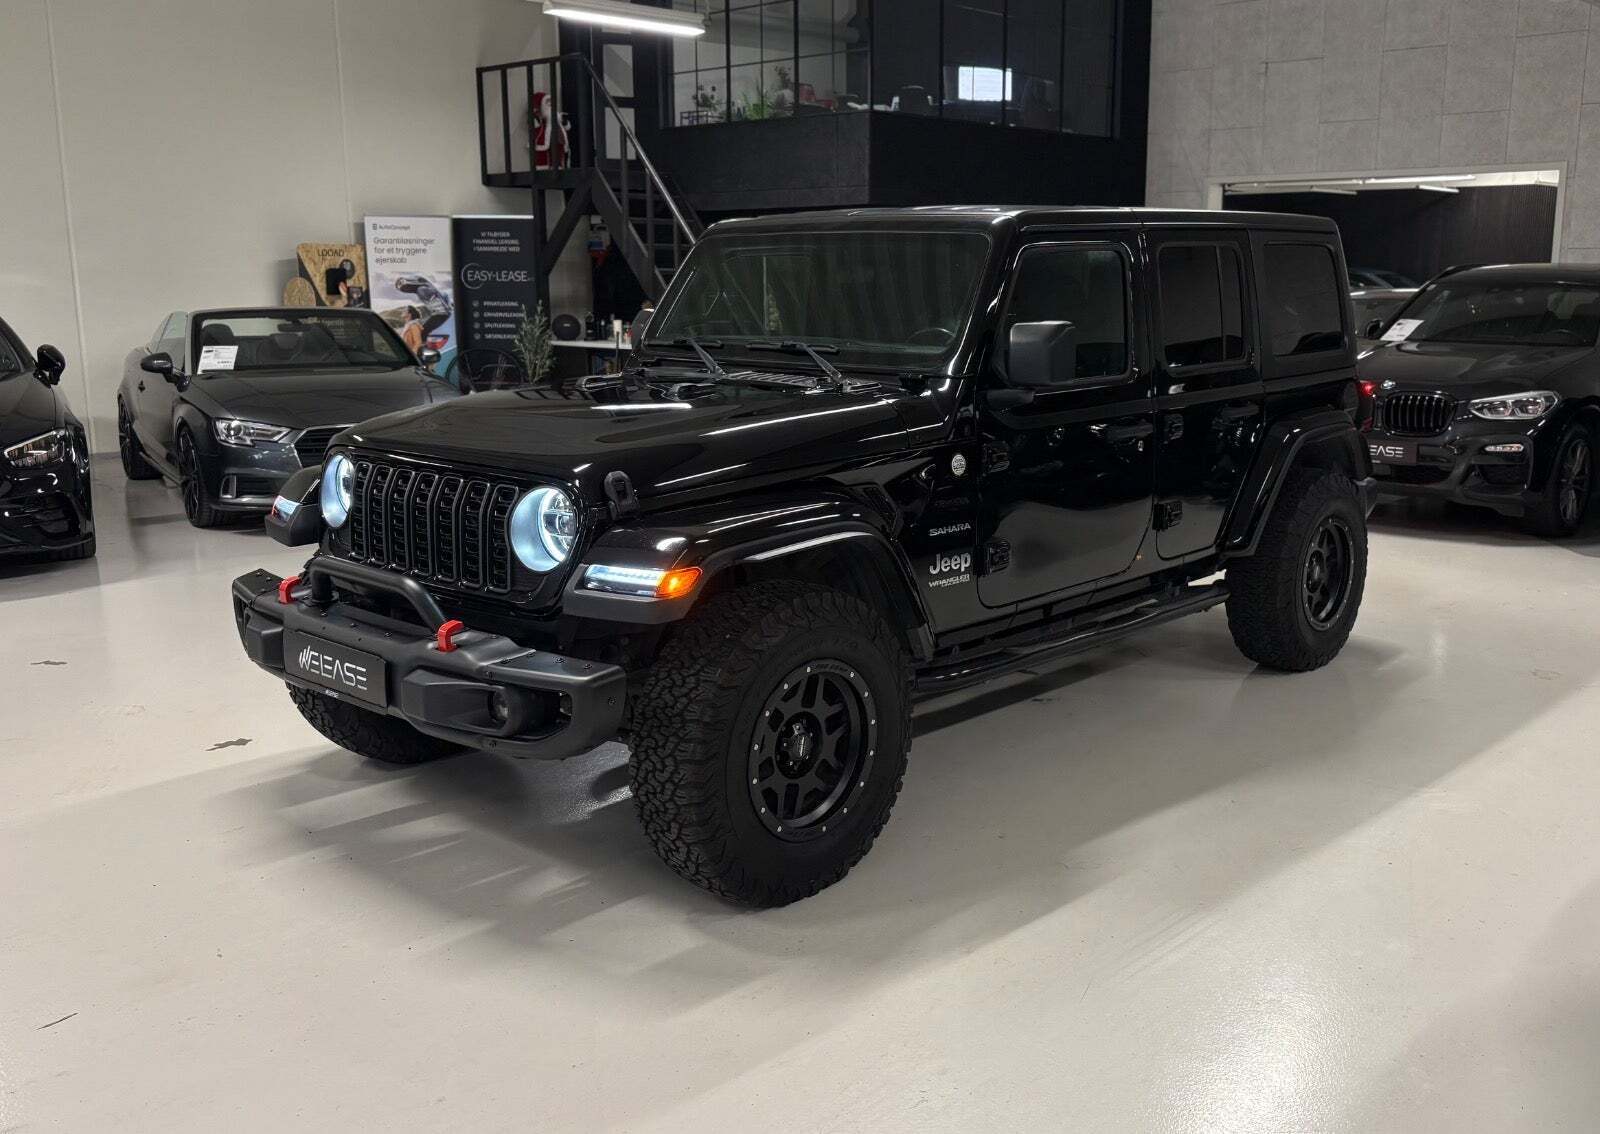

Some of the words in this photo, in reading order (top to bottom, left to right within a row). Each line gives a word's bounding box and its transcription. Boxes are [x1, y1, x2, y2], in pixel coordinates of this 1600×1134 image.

[395, 247, 428, 256] tryggere
[1369, 445, 1404, 458] EASE
[929, 522, 971, 537] SAHARA
[929, 552, 971, 575] Jeep
[928, 573, 970, 588] WRANGLER
